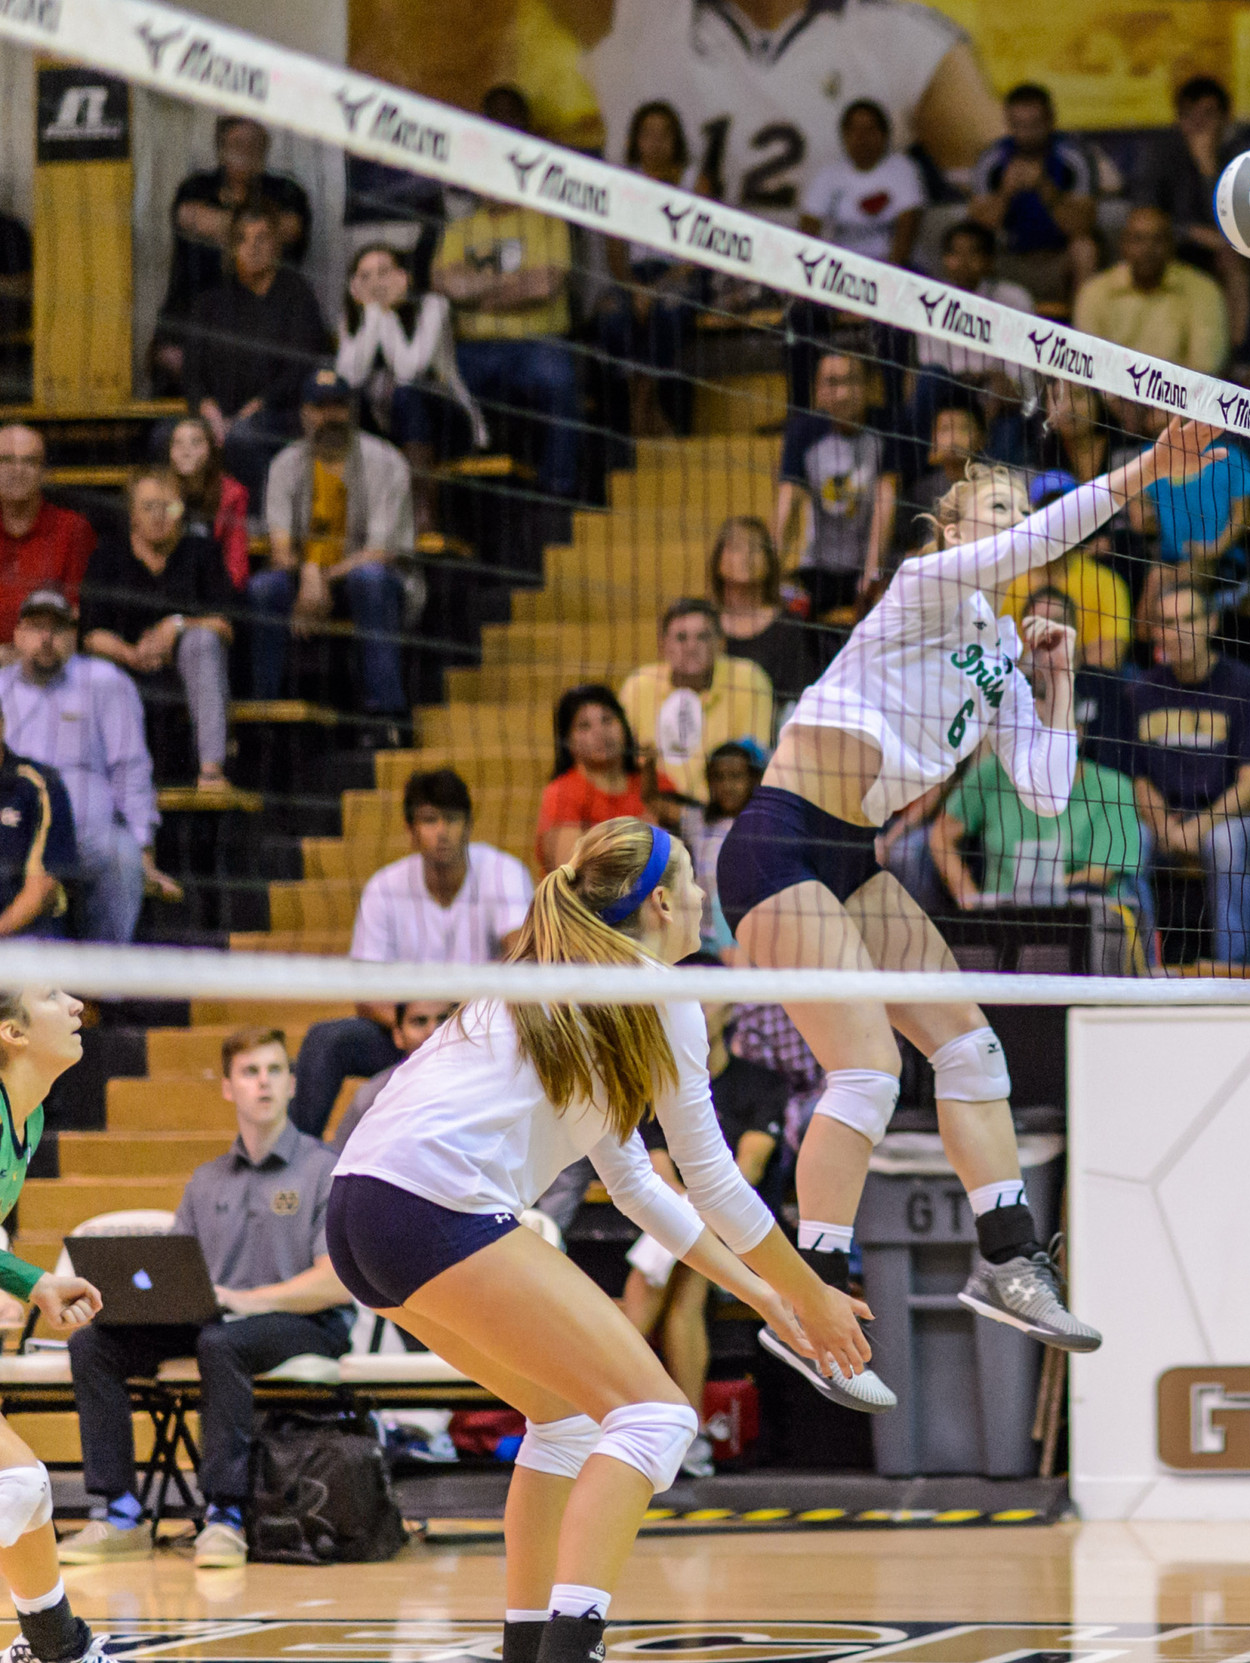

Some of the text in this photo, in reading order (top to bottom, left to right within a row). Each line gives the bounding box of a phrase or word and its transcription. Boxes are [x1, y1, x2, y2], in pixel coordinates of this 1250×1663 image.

[700, 115, 807, 207] 12
[947, 698, 975, 750] 6
[906, 1189, 969, 1235] GT
